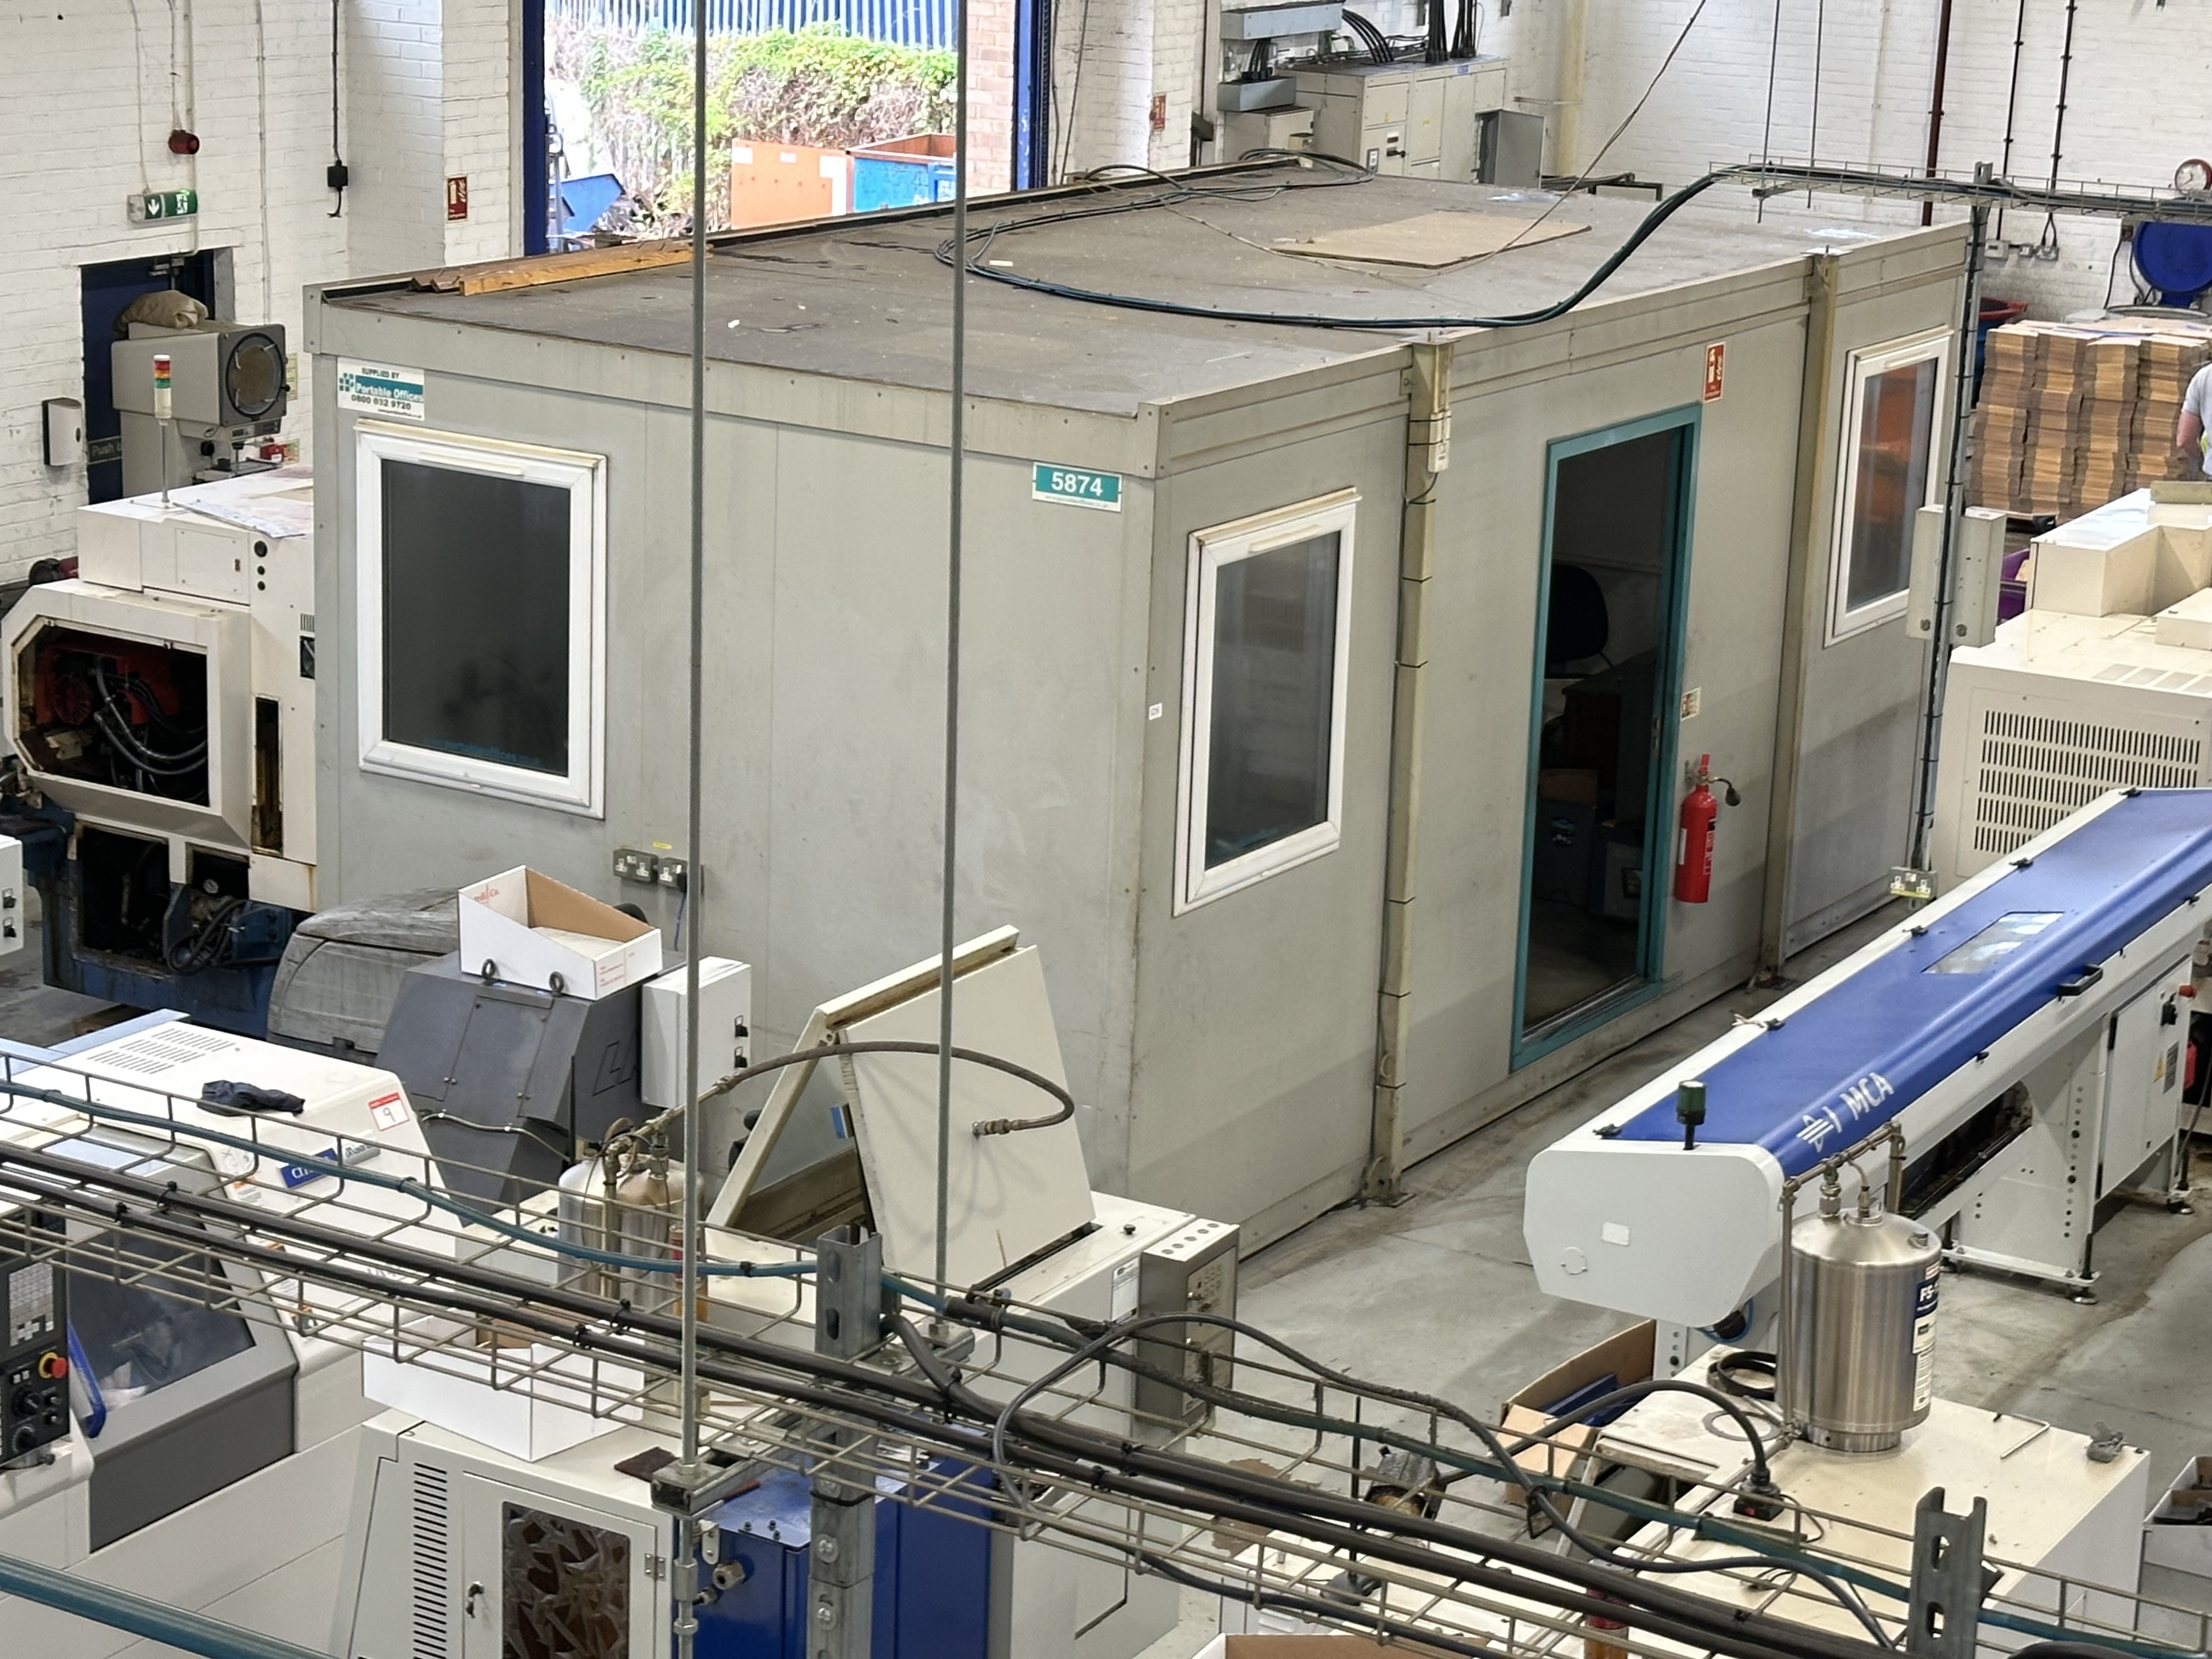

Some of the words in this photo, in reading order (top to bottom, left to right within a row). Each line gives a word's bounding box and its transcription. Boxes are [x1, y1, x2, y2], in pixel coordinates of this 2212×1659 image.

[362, 367, 390, 378] SUPPLIED
[351, 394, 371, 404] 0800
[356, 383, 392, 398] Portable
[393, 388, 424, 402] Offices
[92, 443, 115, 456] Push
[1051, 471, 1103, 496] 5874
[383, 1107, 396, 1122] 9
